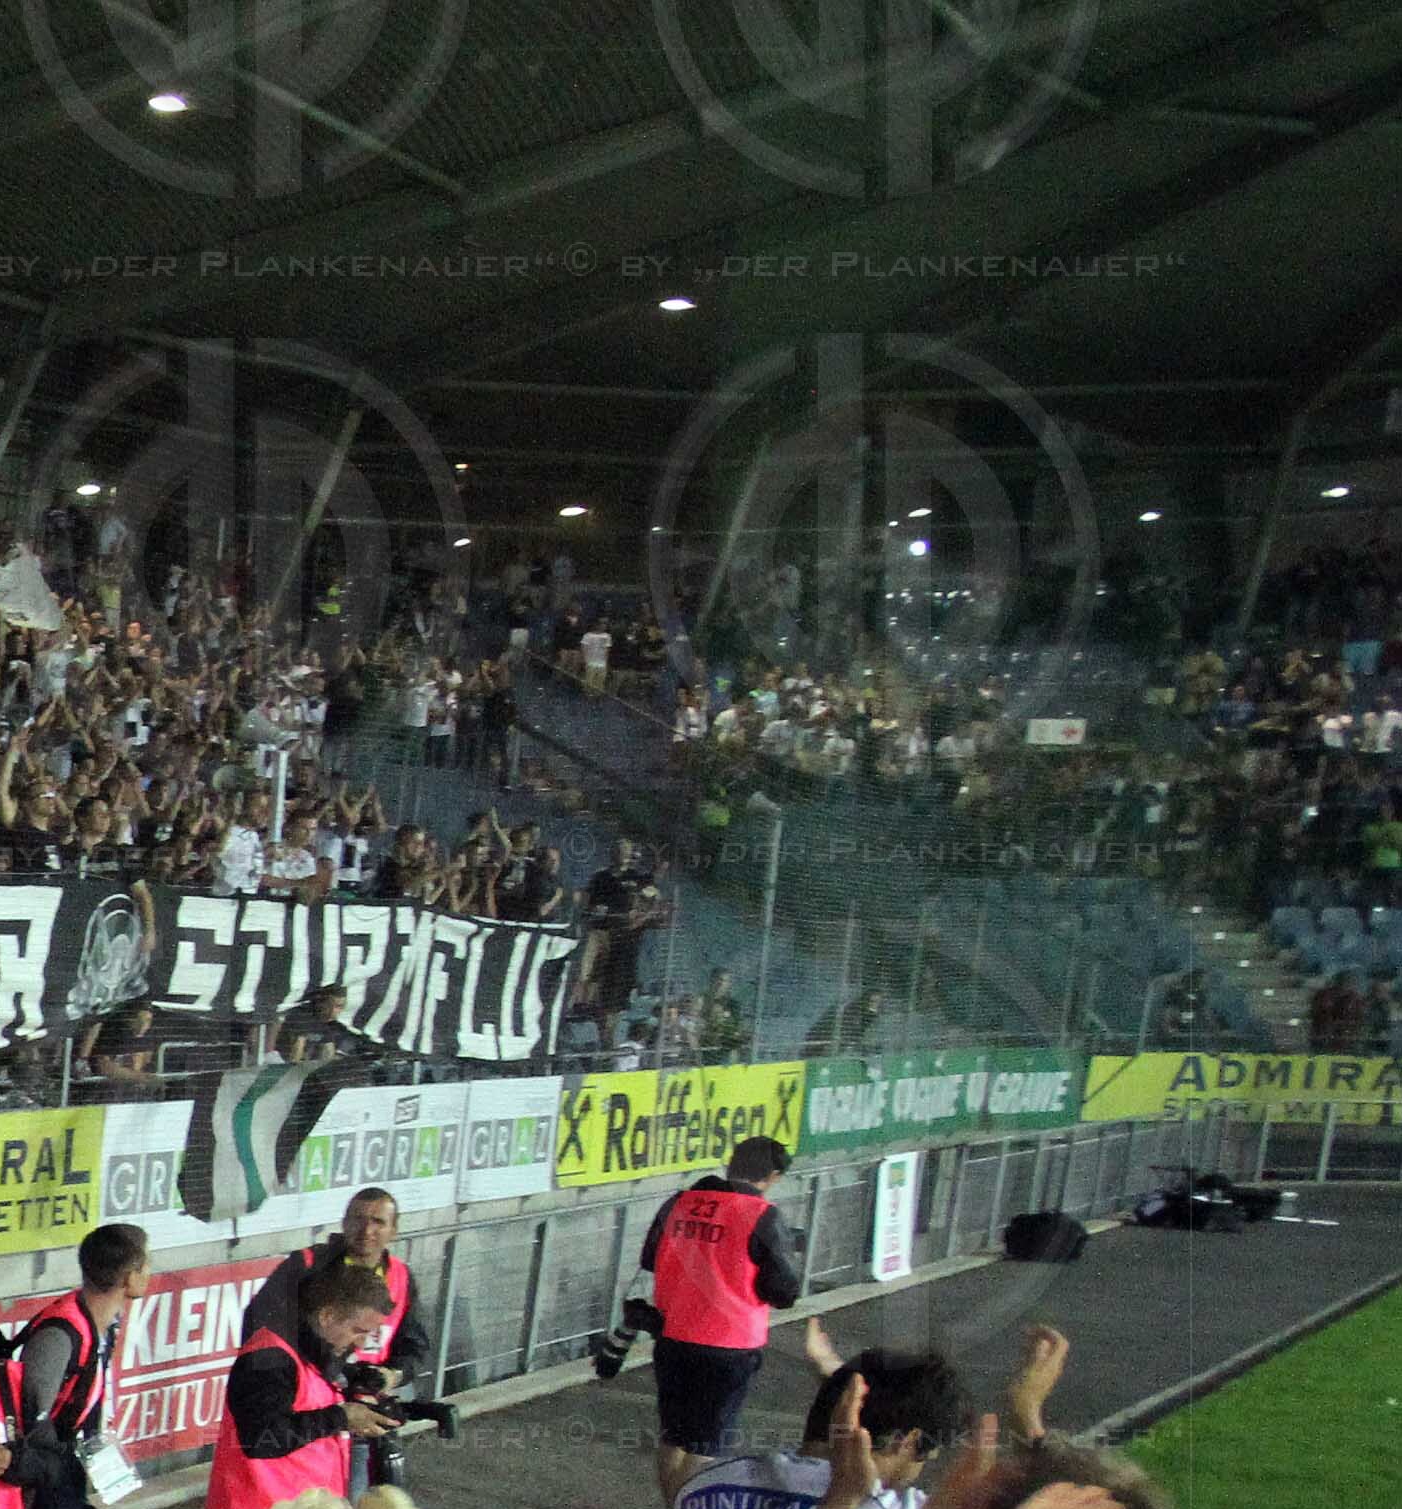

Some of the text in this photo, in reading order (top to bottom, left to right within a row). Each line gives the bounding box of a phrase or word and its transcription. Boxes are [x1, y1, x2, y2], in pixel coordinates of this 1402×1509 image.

[361, 1122, 458, 1184] GRAZ
[469, 1115, 552, 1170] GRAZ
[603, 1079, 766, 1173] Raiffeisen
[673, 1219, 726, 1244] FOTO
[690, 1198, 718, 1218] 23
[116, 1373, 229, 1445] ZEITU
